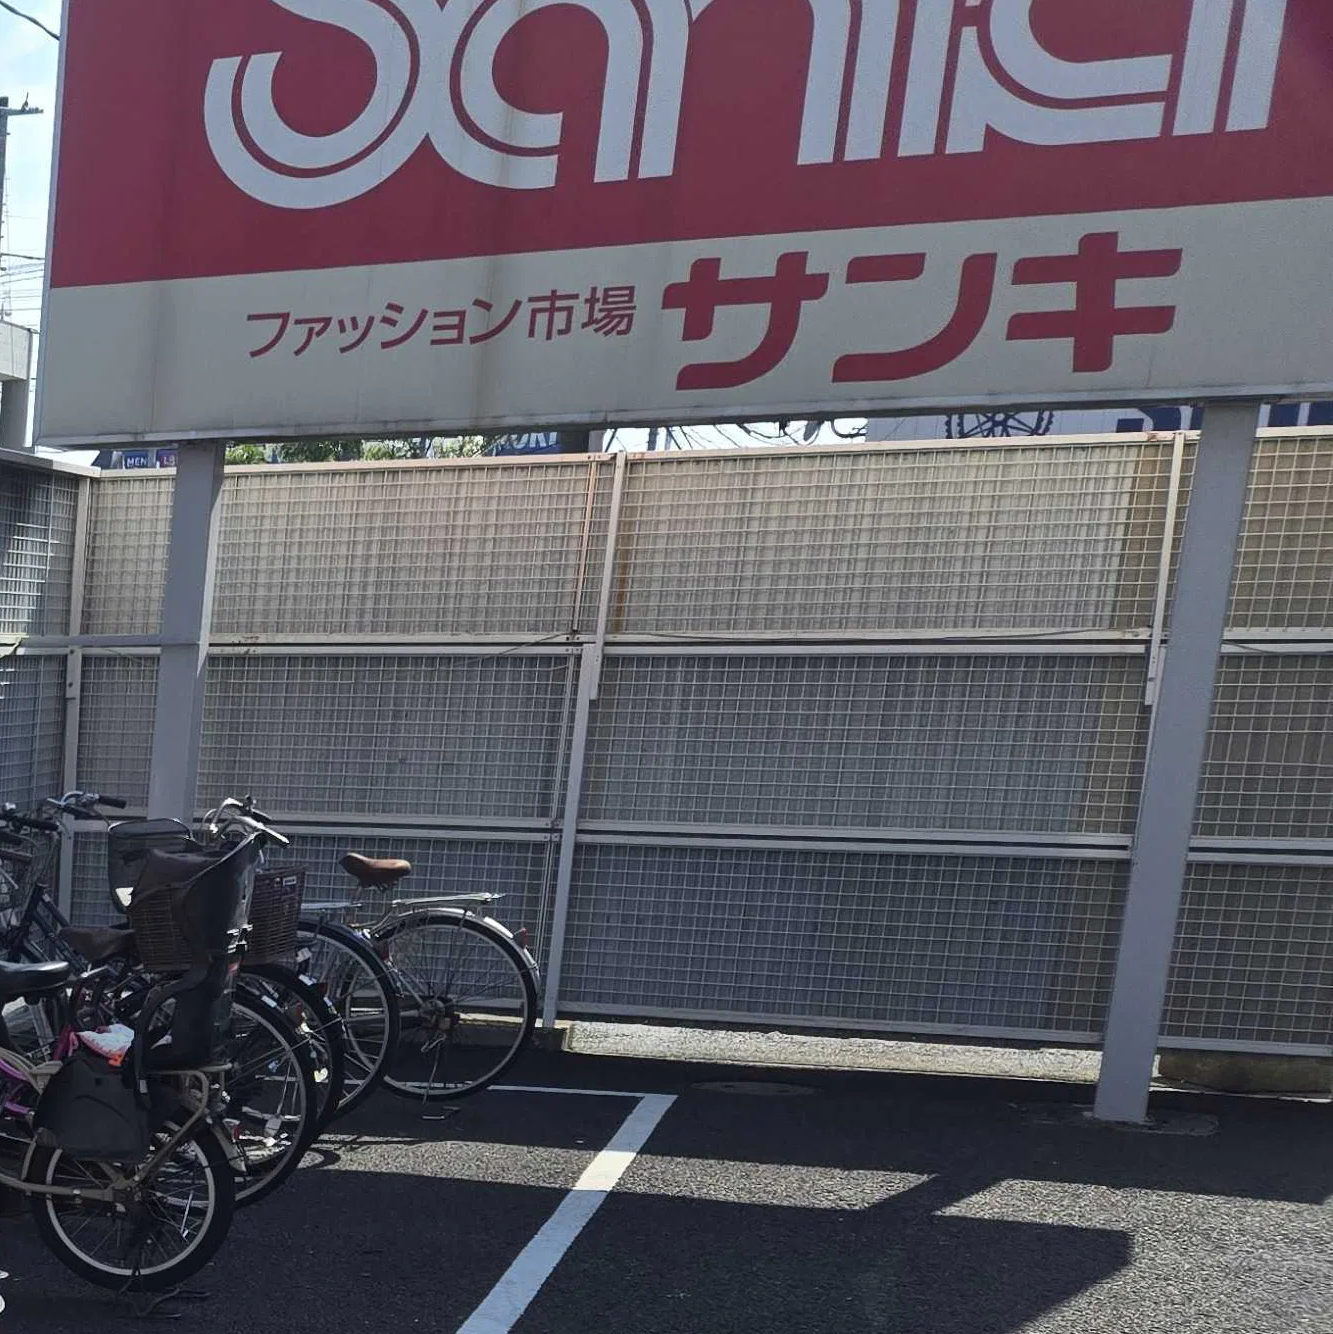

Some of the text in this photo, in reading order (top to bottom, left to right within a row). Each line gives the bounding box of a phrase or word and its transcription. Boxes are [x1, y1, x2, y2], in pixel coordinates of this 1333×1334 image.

[246, 231, 1183, 391] ファッション市場 サンキ
